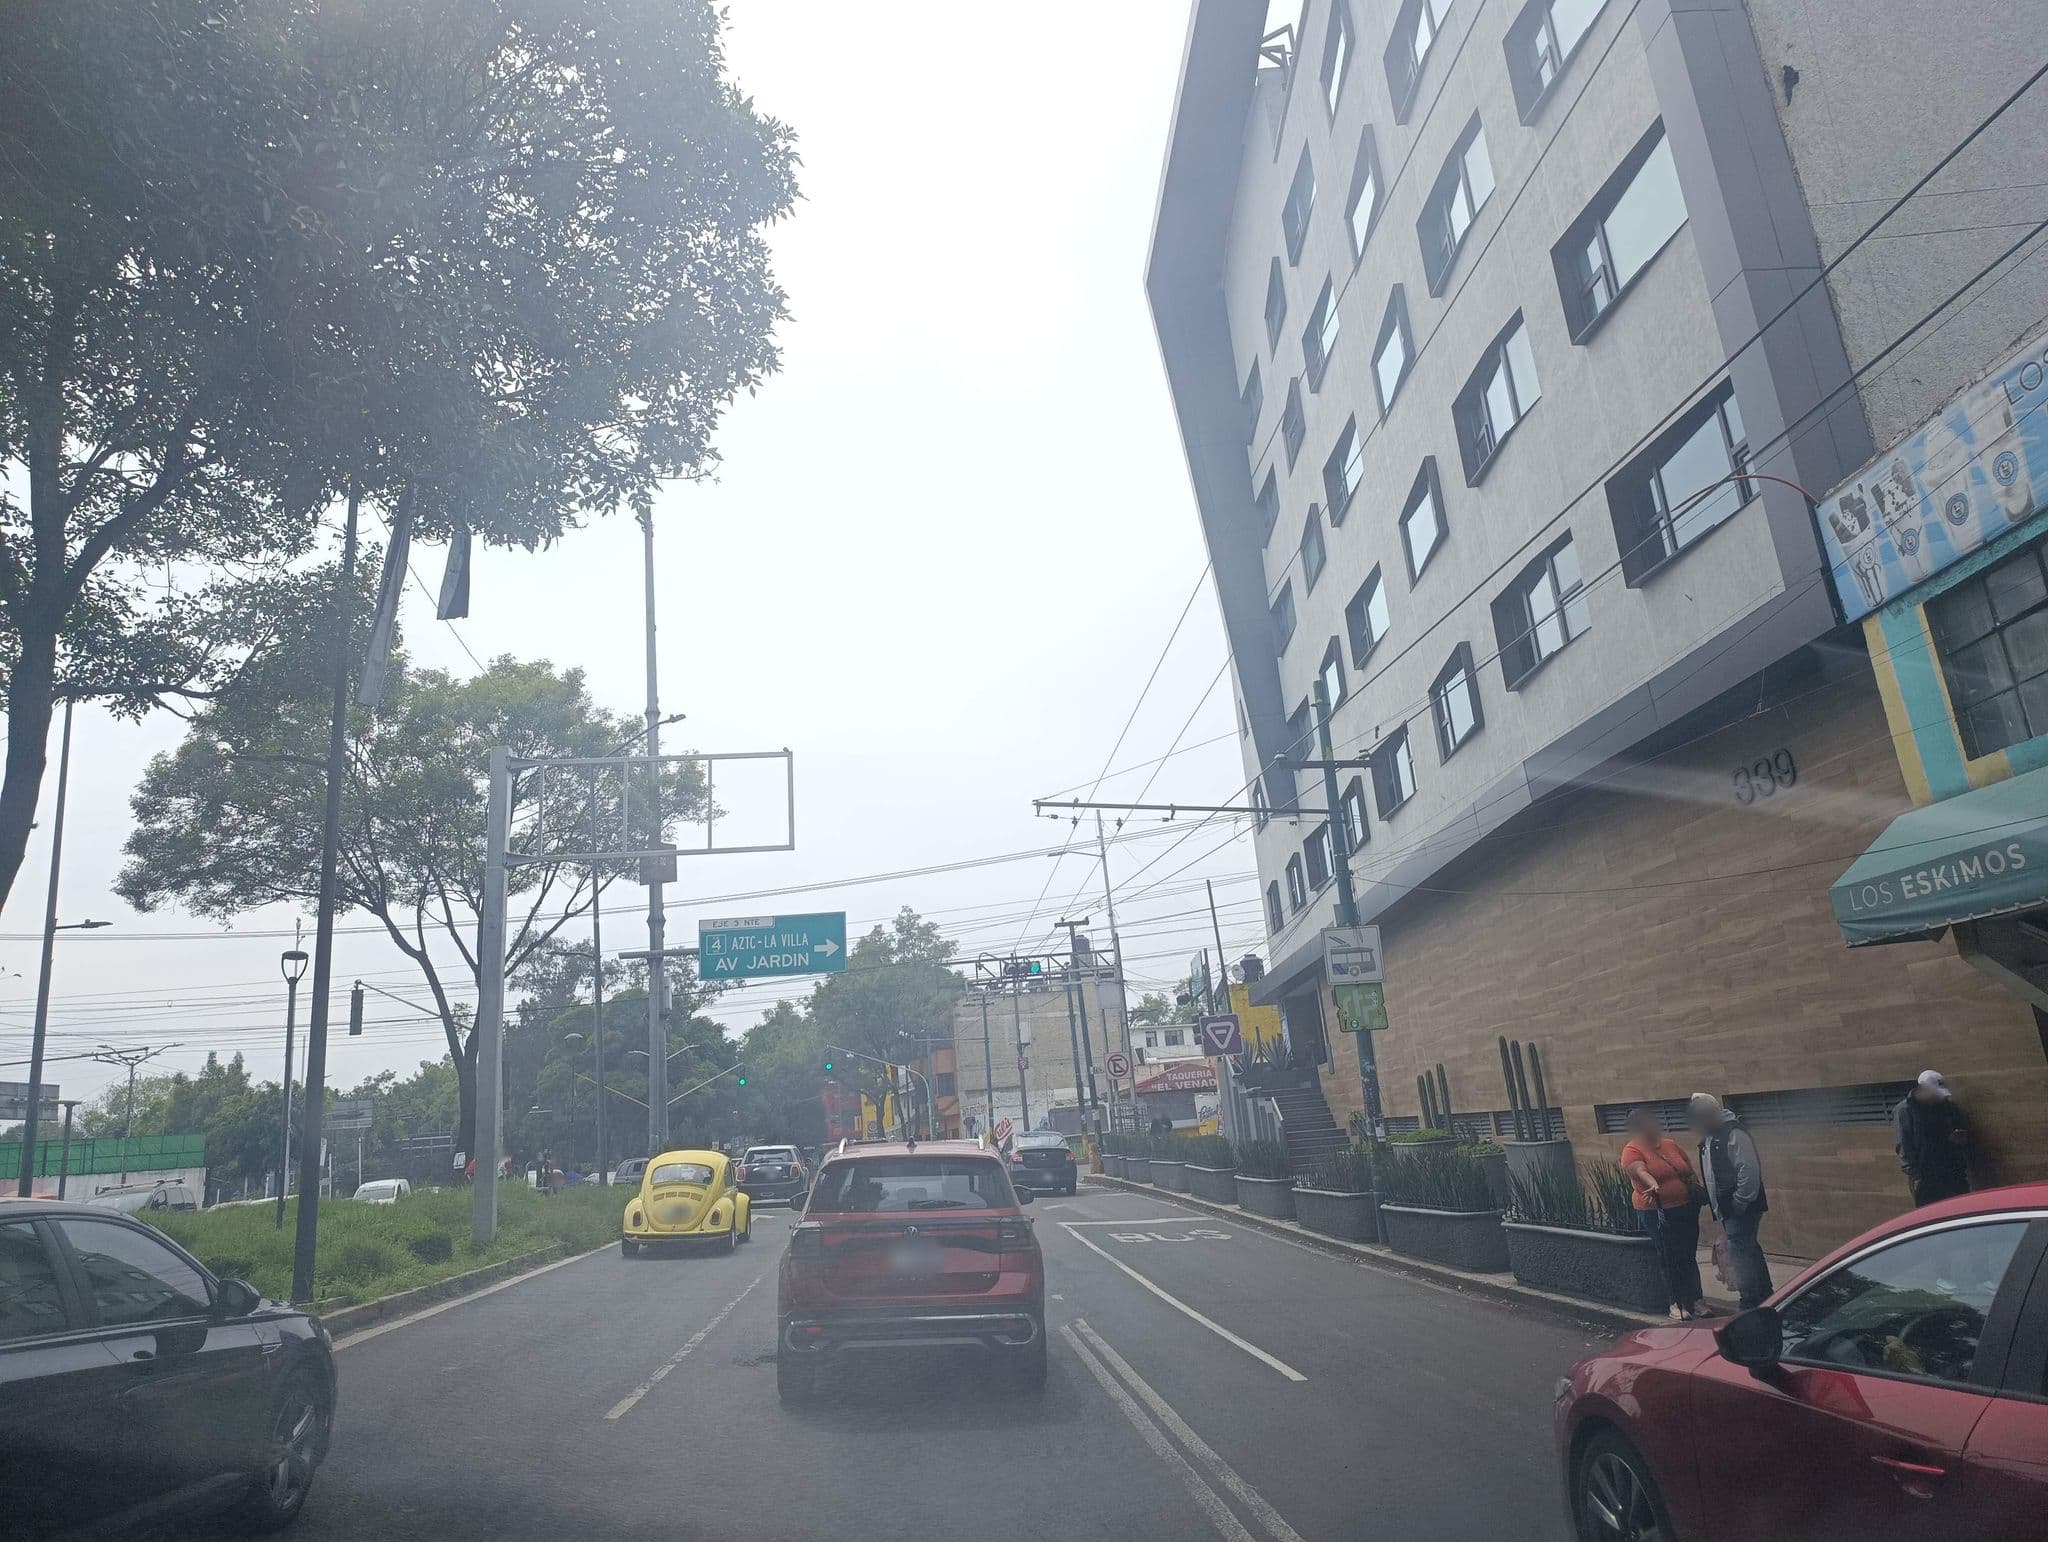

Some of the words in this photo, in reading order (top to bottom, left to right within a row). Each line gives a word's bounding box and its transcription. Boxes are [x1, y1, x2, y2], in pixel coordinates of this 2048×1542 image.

[2002, 347, 2048, 406] LO
[1733, 747, 1798, 805] 339
[1849, 880, 1894, 912] LOS
[712, 920, 729, 928] EJE
[744, 918, 761, 927] NTE
[781, 932, 809, 947] VILLA
[715, 957, 738, 971] AV
[746, 952, 809, 970] JARDIN
[1166, 1069, 1213, 1081] TAQUERIA
[1108, 1229, 1233, 1243] BUS
